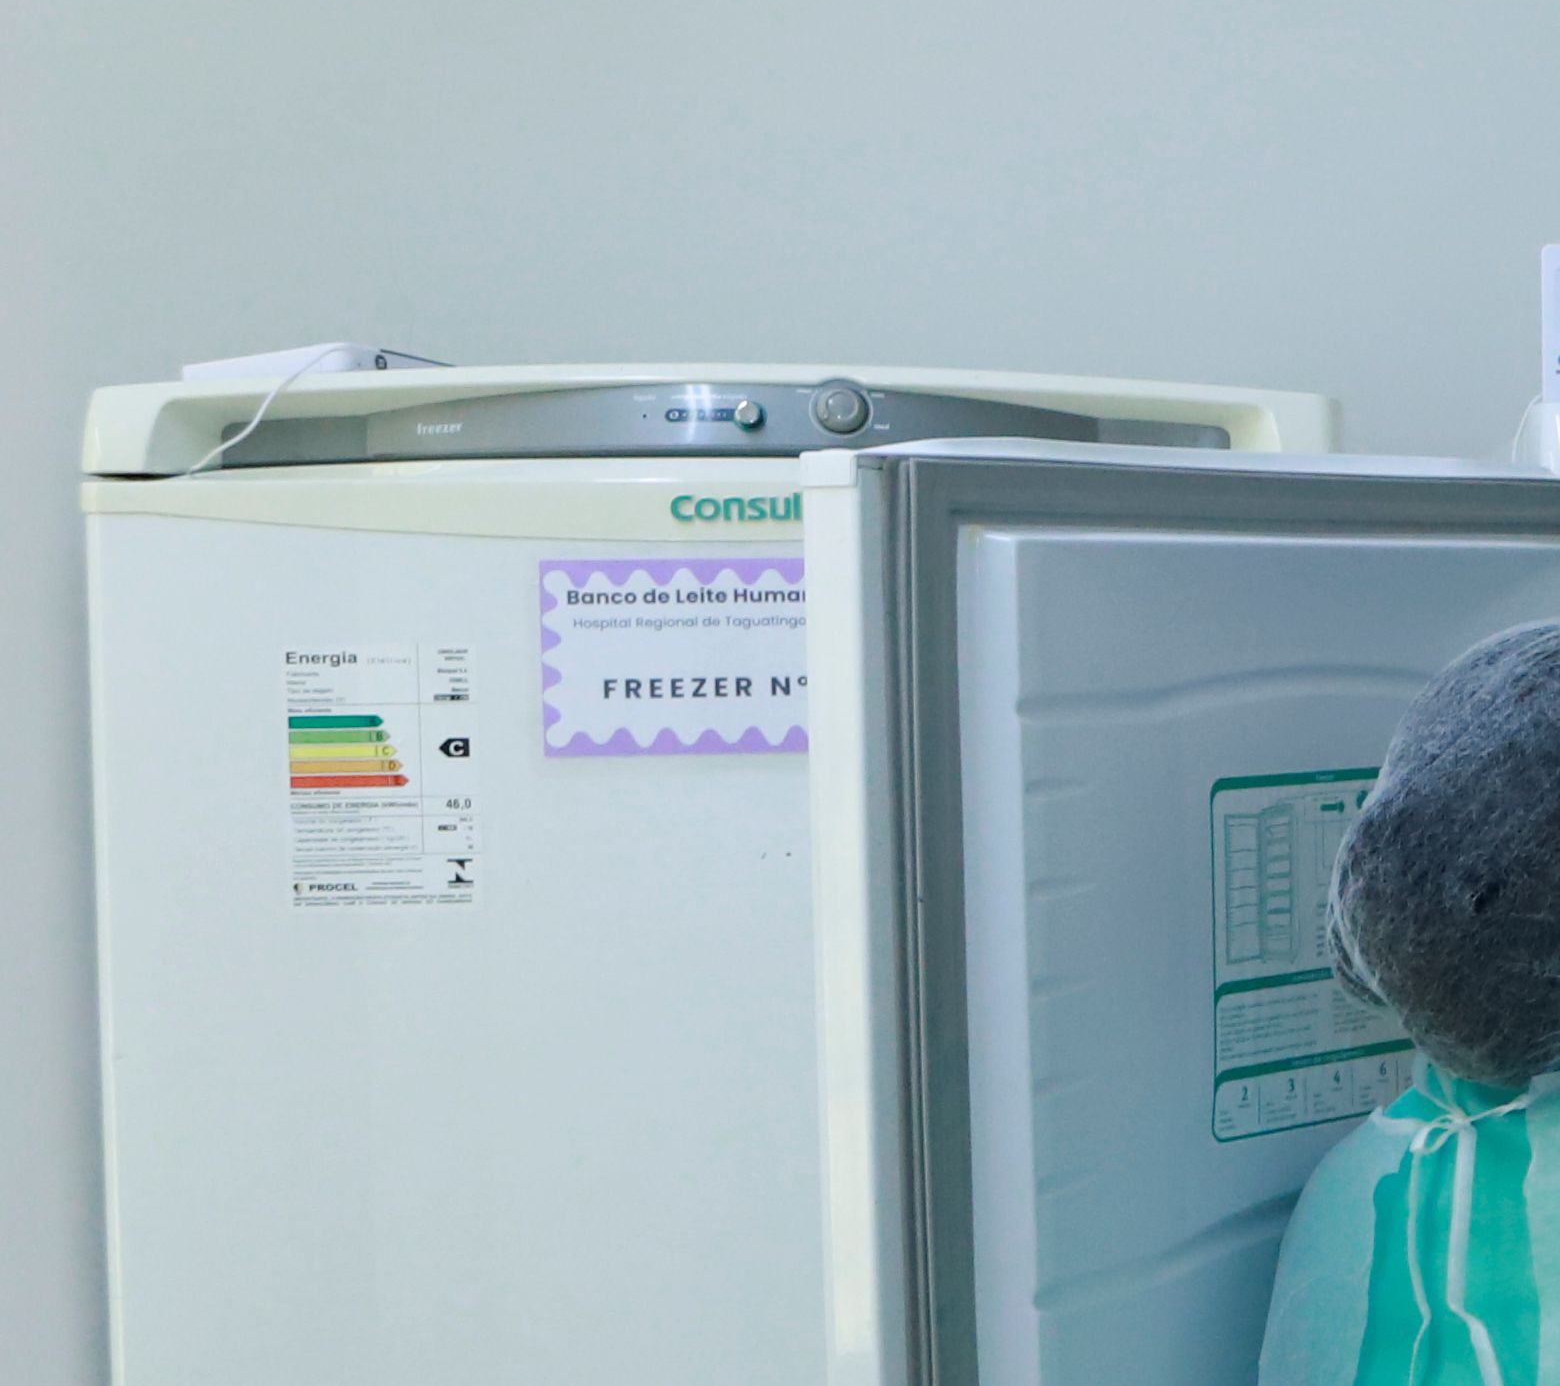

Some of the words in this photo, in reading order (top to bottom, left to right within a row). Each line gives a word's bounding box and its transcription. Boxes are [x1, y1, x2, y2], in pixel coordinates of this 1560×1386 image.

[416, 421, 463, 436] freezer
[670, 492, 804, 522] Consul
[567, 589, 637, 605] Banco
[643, 588, 670, 604] de
[676, 587, 727, 604] Leite
[573, 615, 632, 631] Hospital
[636, 615, 698, 631] Regional
[702, 615, 720, 627] de
[285, 651, 358, 667] Energia
[603, 677, 752, 699] FREEZER
[375, 732, 383, 741] B
[382, 746, 390, 756] C
[449, 741, 465, 755] C
[388, 761, 396, 770] D
[445, 798, 472, 810] 46,0
[309, 883, 358, 892] PROCEL
[1288, 1078, 1295, 1093] 3
[1241, 1086, 1248, 1101] 2
